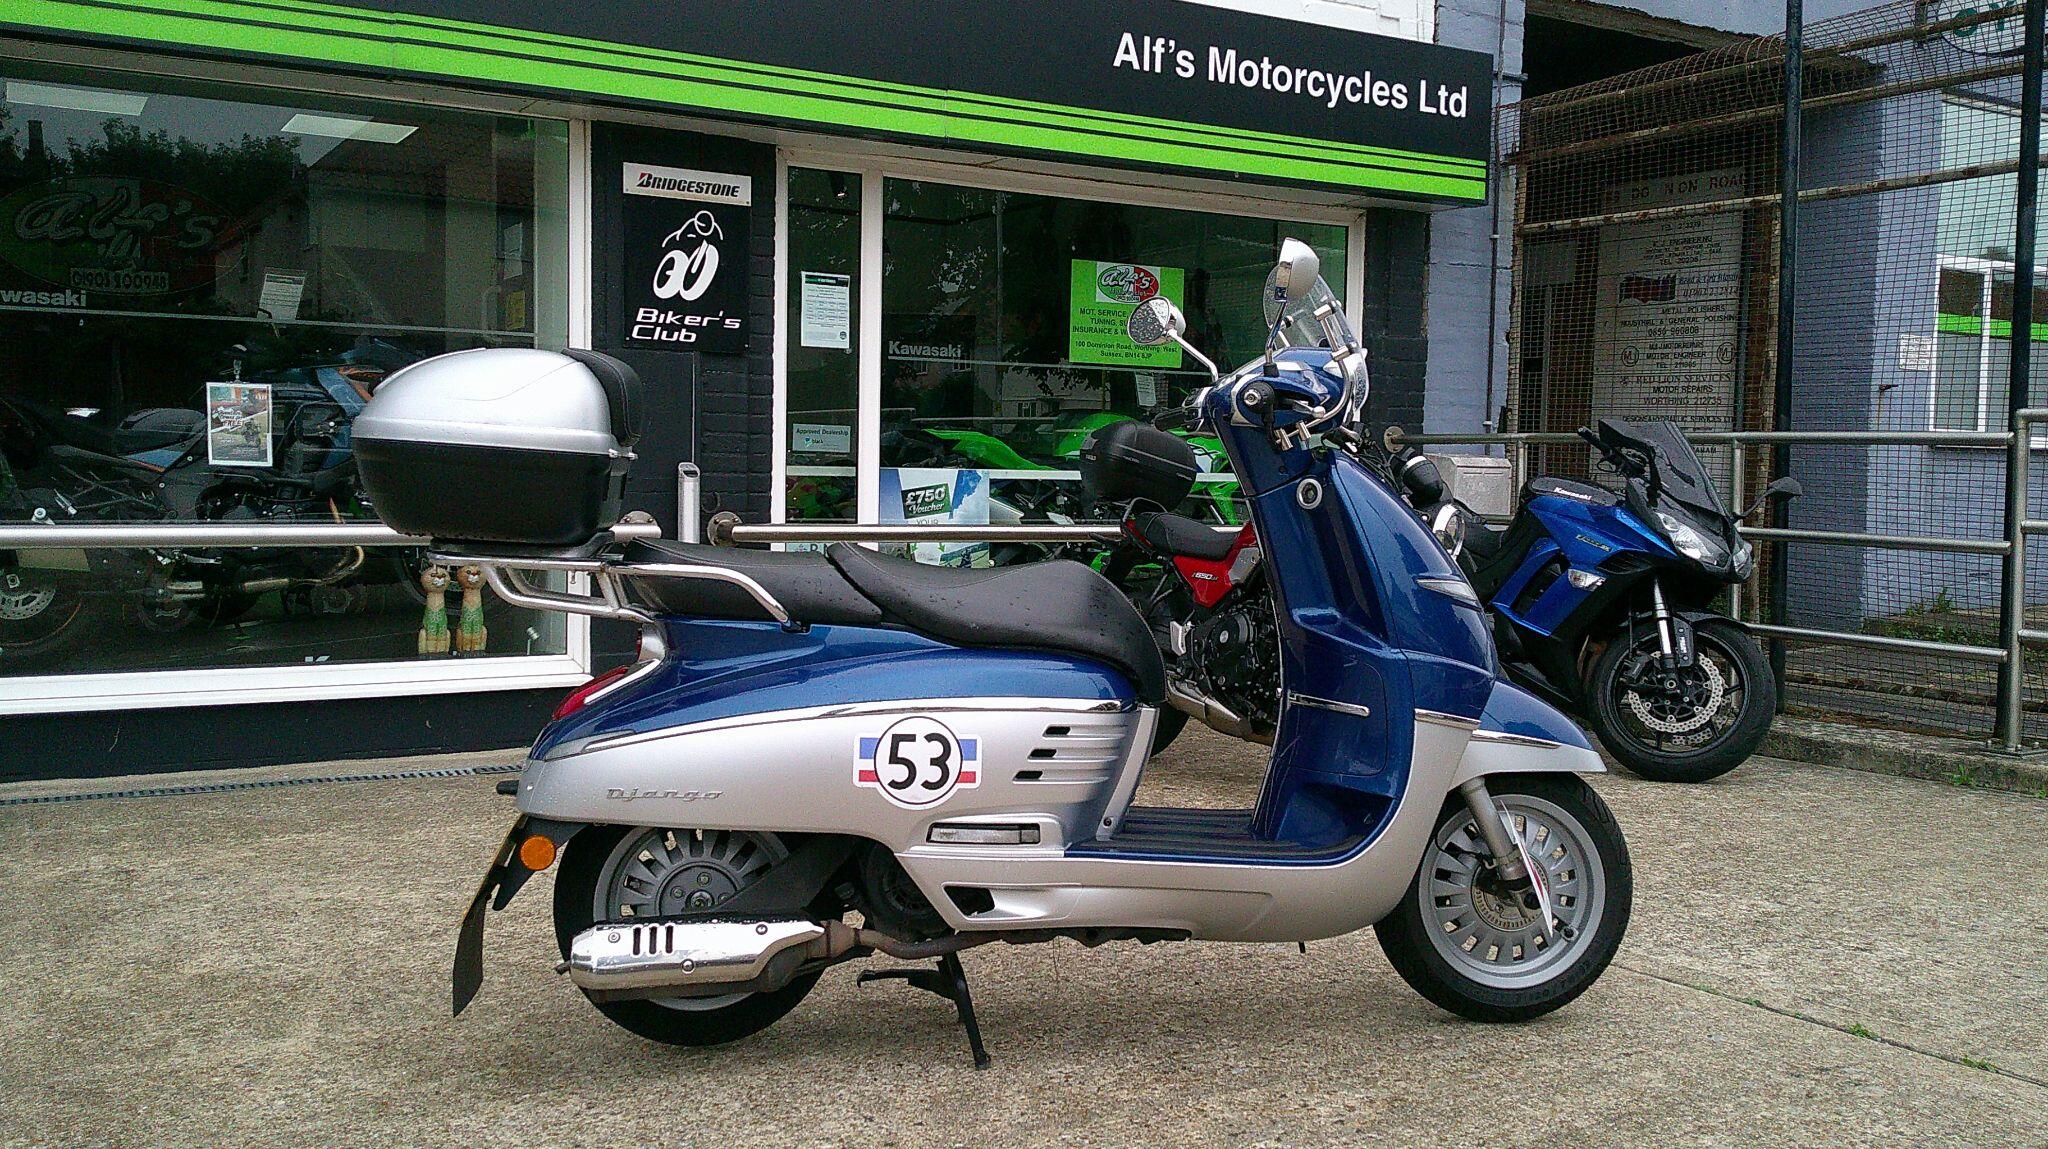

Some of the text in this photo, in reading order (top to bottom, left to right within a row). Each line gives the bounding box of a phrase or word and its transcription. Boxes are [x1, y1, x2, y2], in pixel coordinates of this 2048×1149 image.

[1113, 32, 1467, 118] Alf's Motorcycles Ltd
[637, 172, 740, 198] BRIDGESTONE
[635, 306, 742, 330] Biker's
[631, 324, 697, 343] Club
[1072, 325, 1112, 335] INSURANCE
[888, 340, 962, 358] Kawasaki
[1553, 486, 1592, 501] Kawasaki
[908, 503, 944, 514] Voucher
[887, 732, 952, 791] 53
[606, 785, 724, 803] Django
